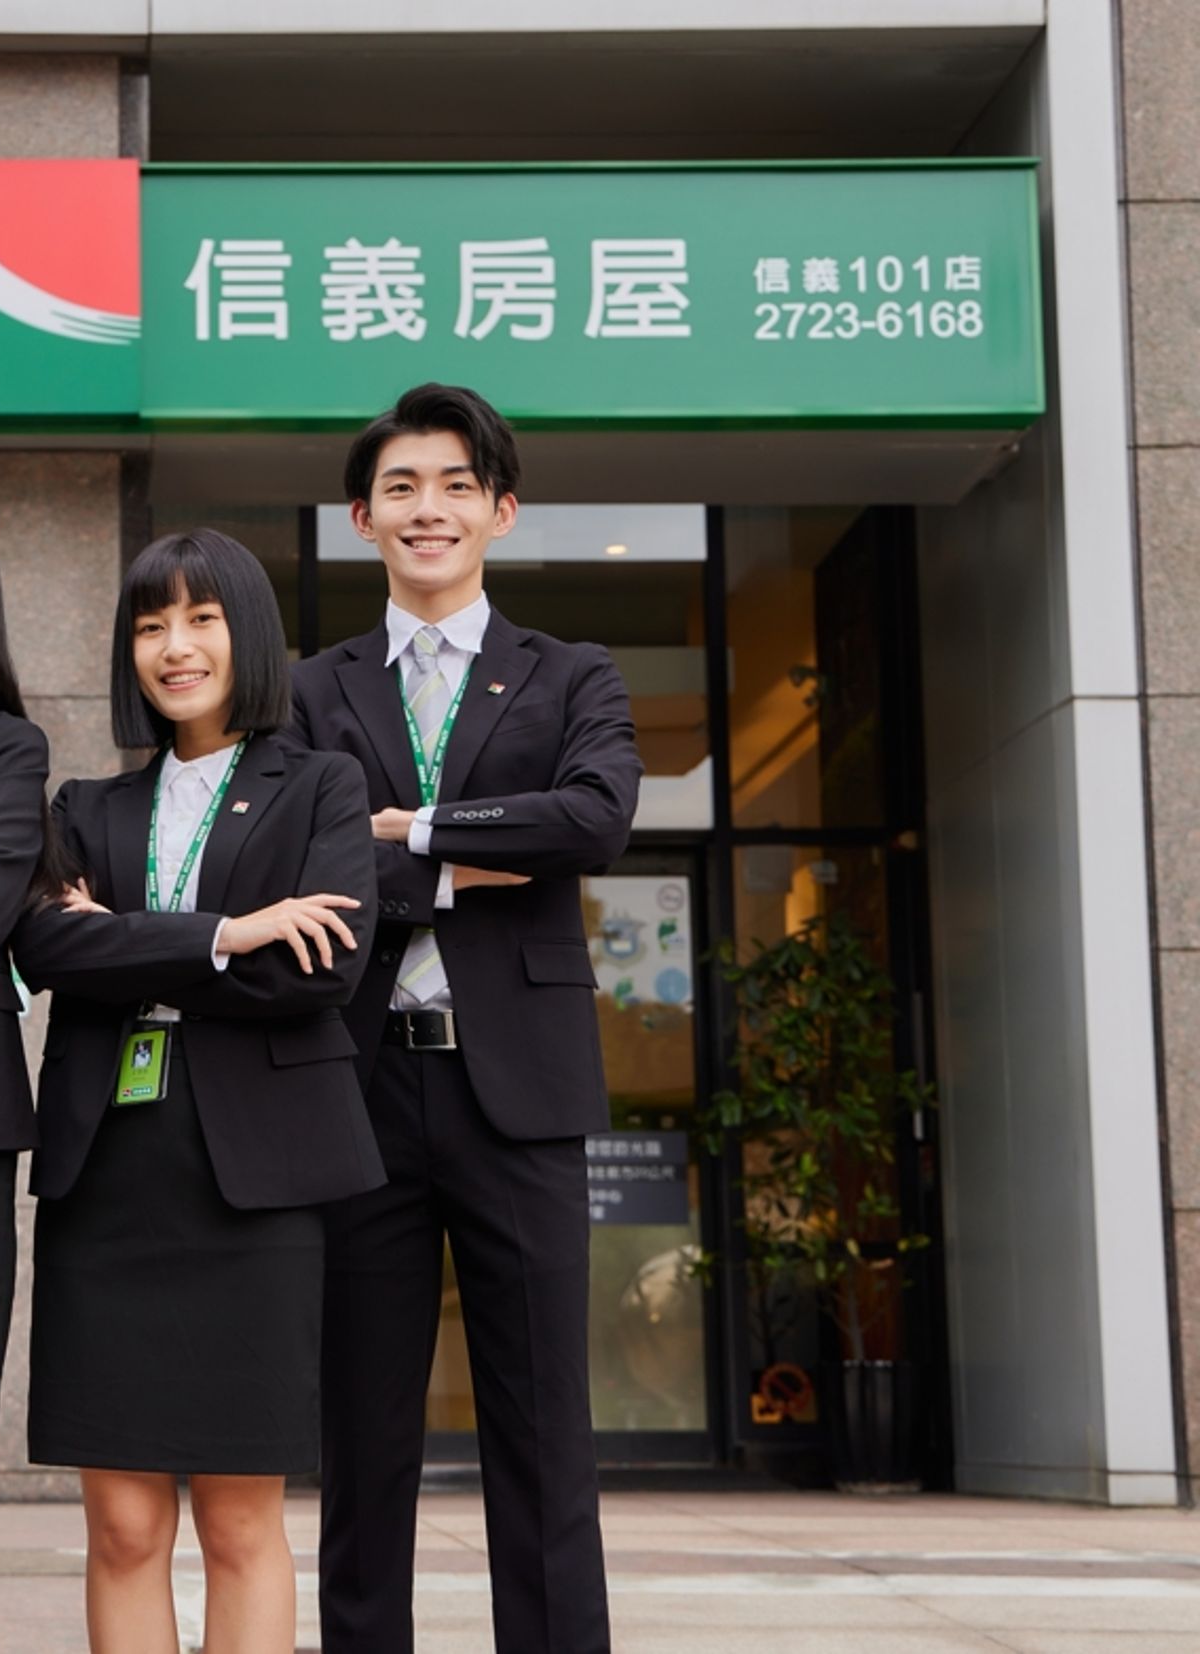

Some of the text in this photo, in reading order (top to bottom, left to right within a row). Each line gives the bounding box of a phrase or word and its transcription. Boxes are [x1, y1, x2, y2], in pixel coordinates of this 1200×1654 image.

[184, 237, 692, 341] 信義房屋
[753, 255, 982, 294] 信義101店
[754, 299, 984, 340] 2723-6168
